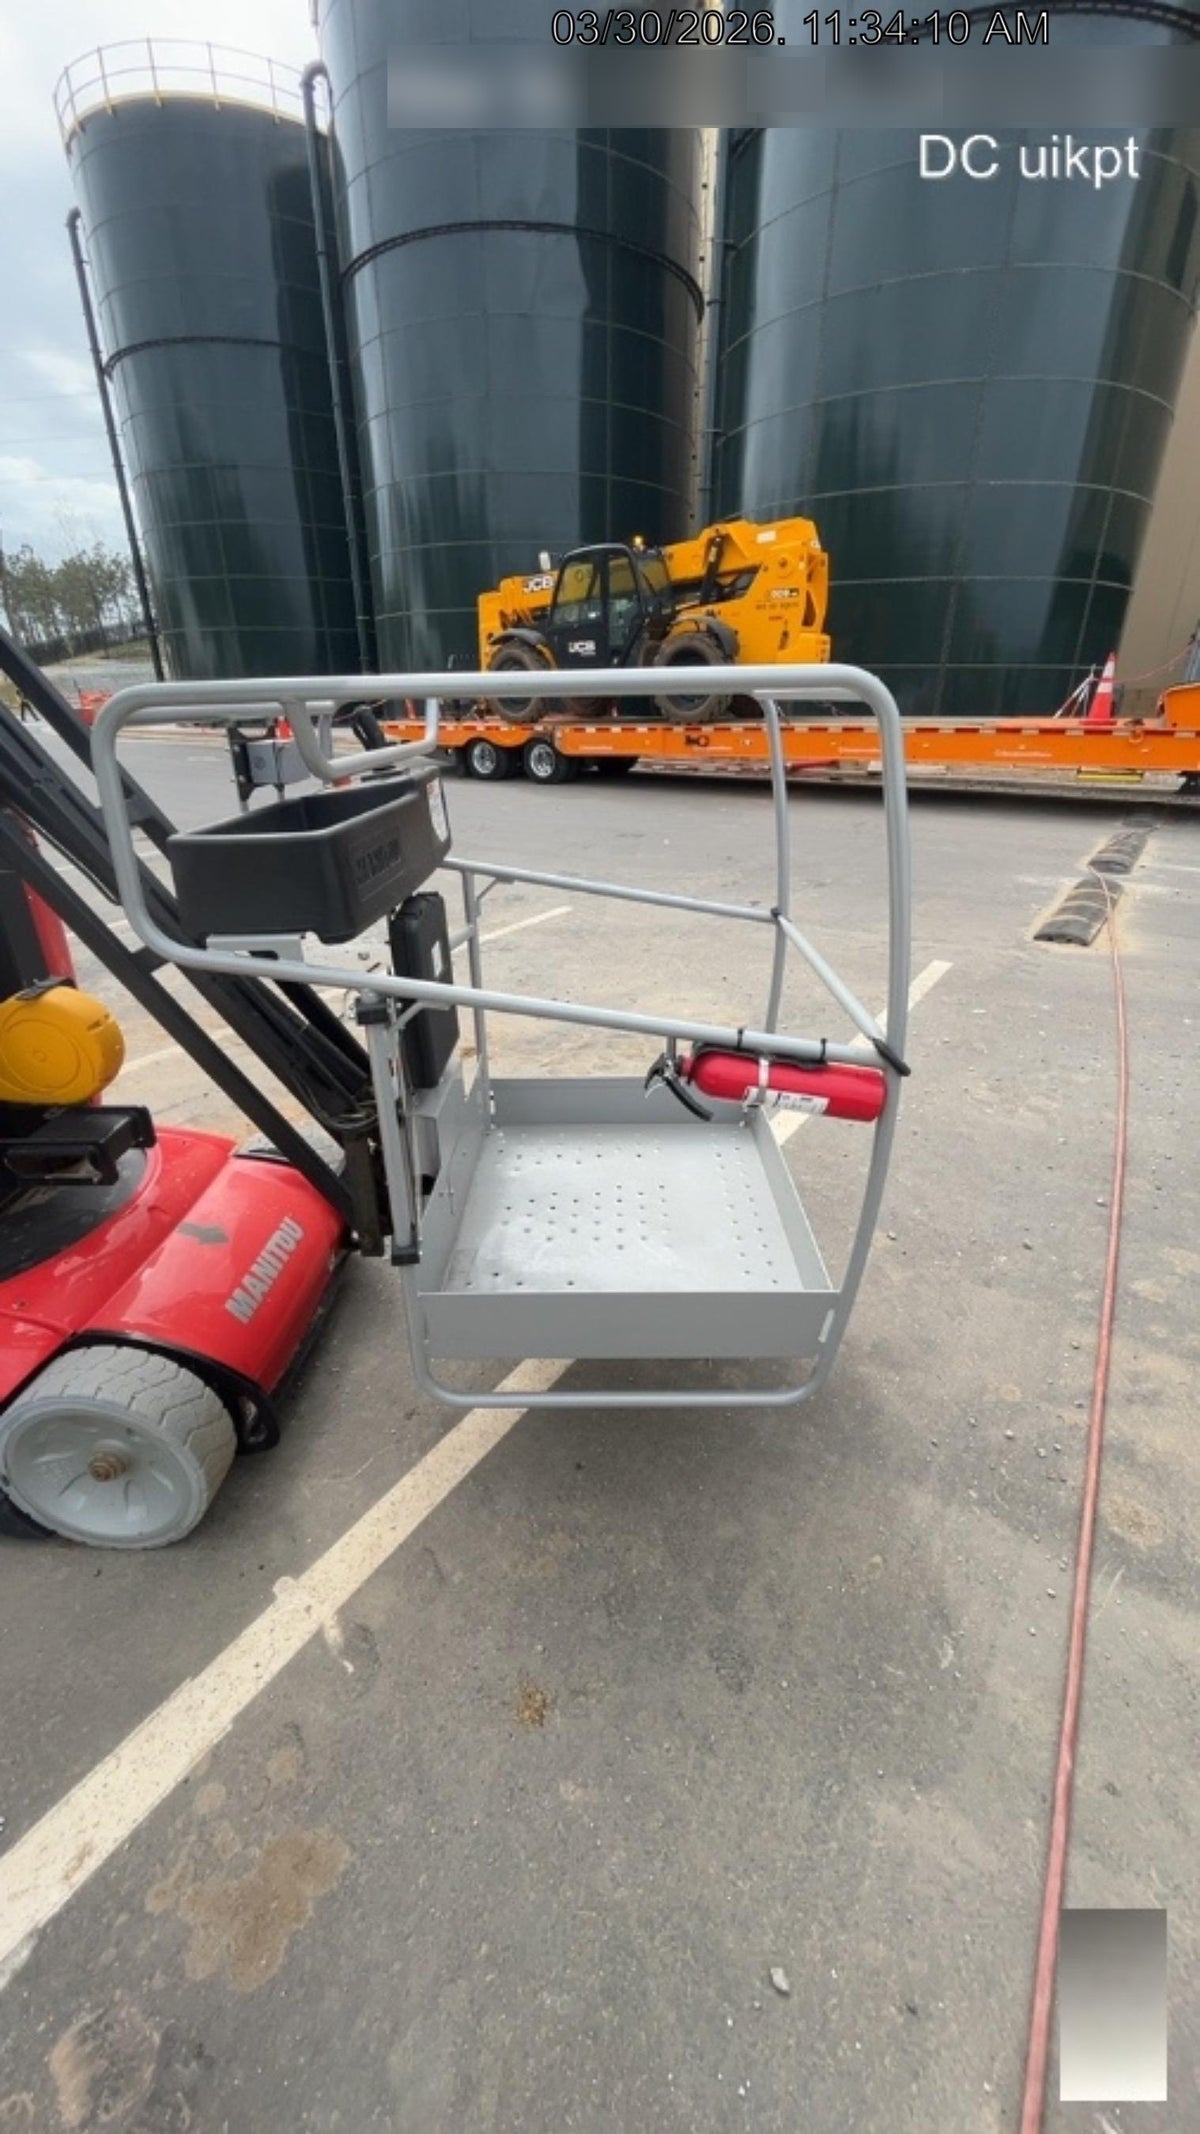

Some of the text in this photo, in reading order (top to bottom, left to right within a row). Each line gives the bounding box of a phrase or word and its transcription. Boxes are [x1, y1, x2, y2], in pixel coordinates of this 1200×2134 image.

[523, 575, 554, 593] JCB
[568, 640, 597, 654] JCB
[224, 1215, 304, 1325] MANITOU
